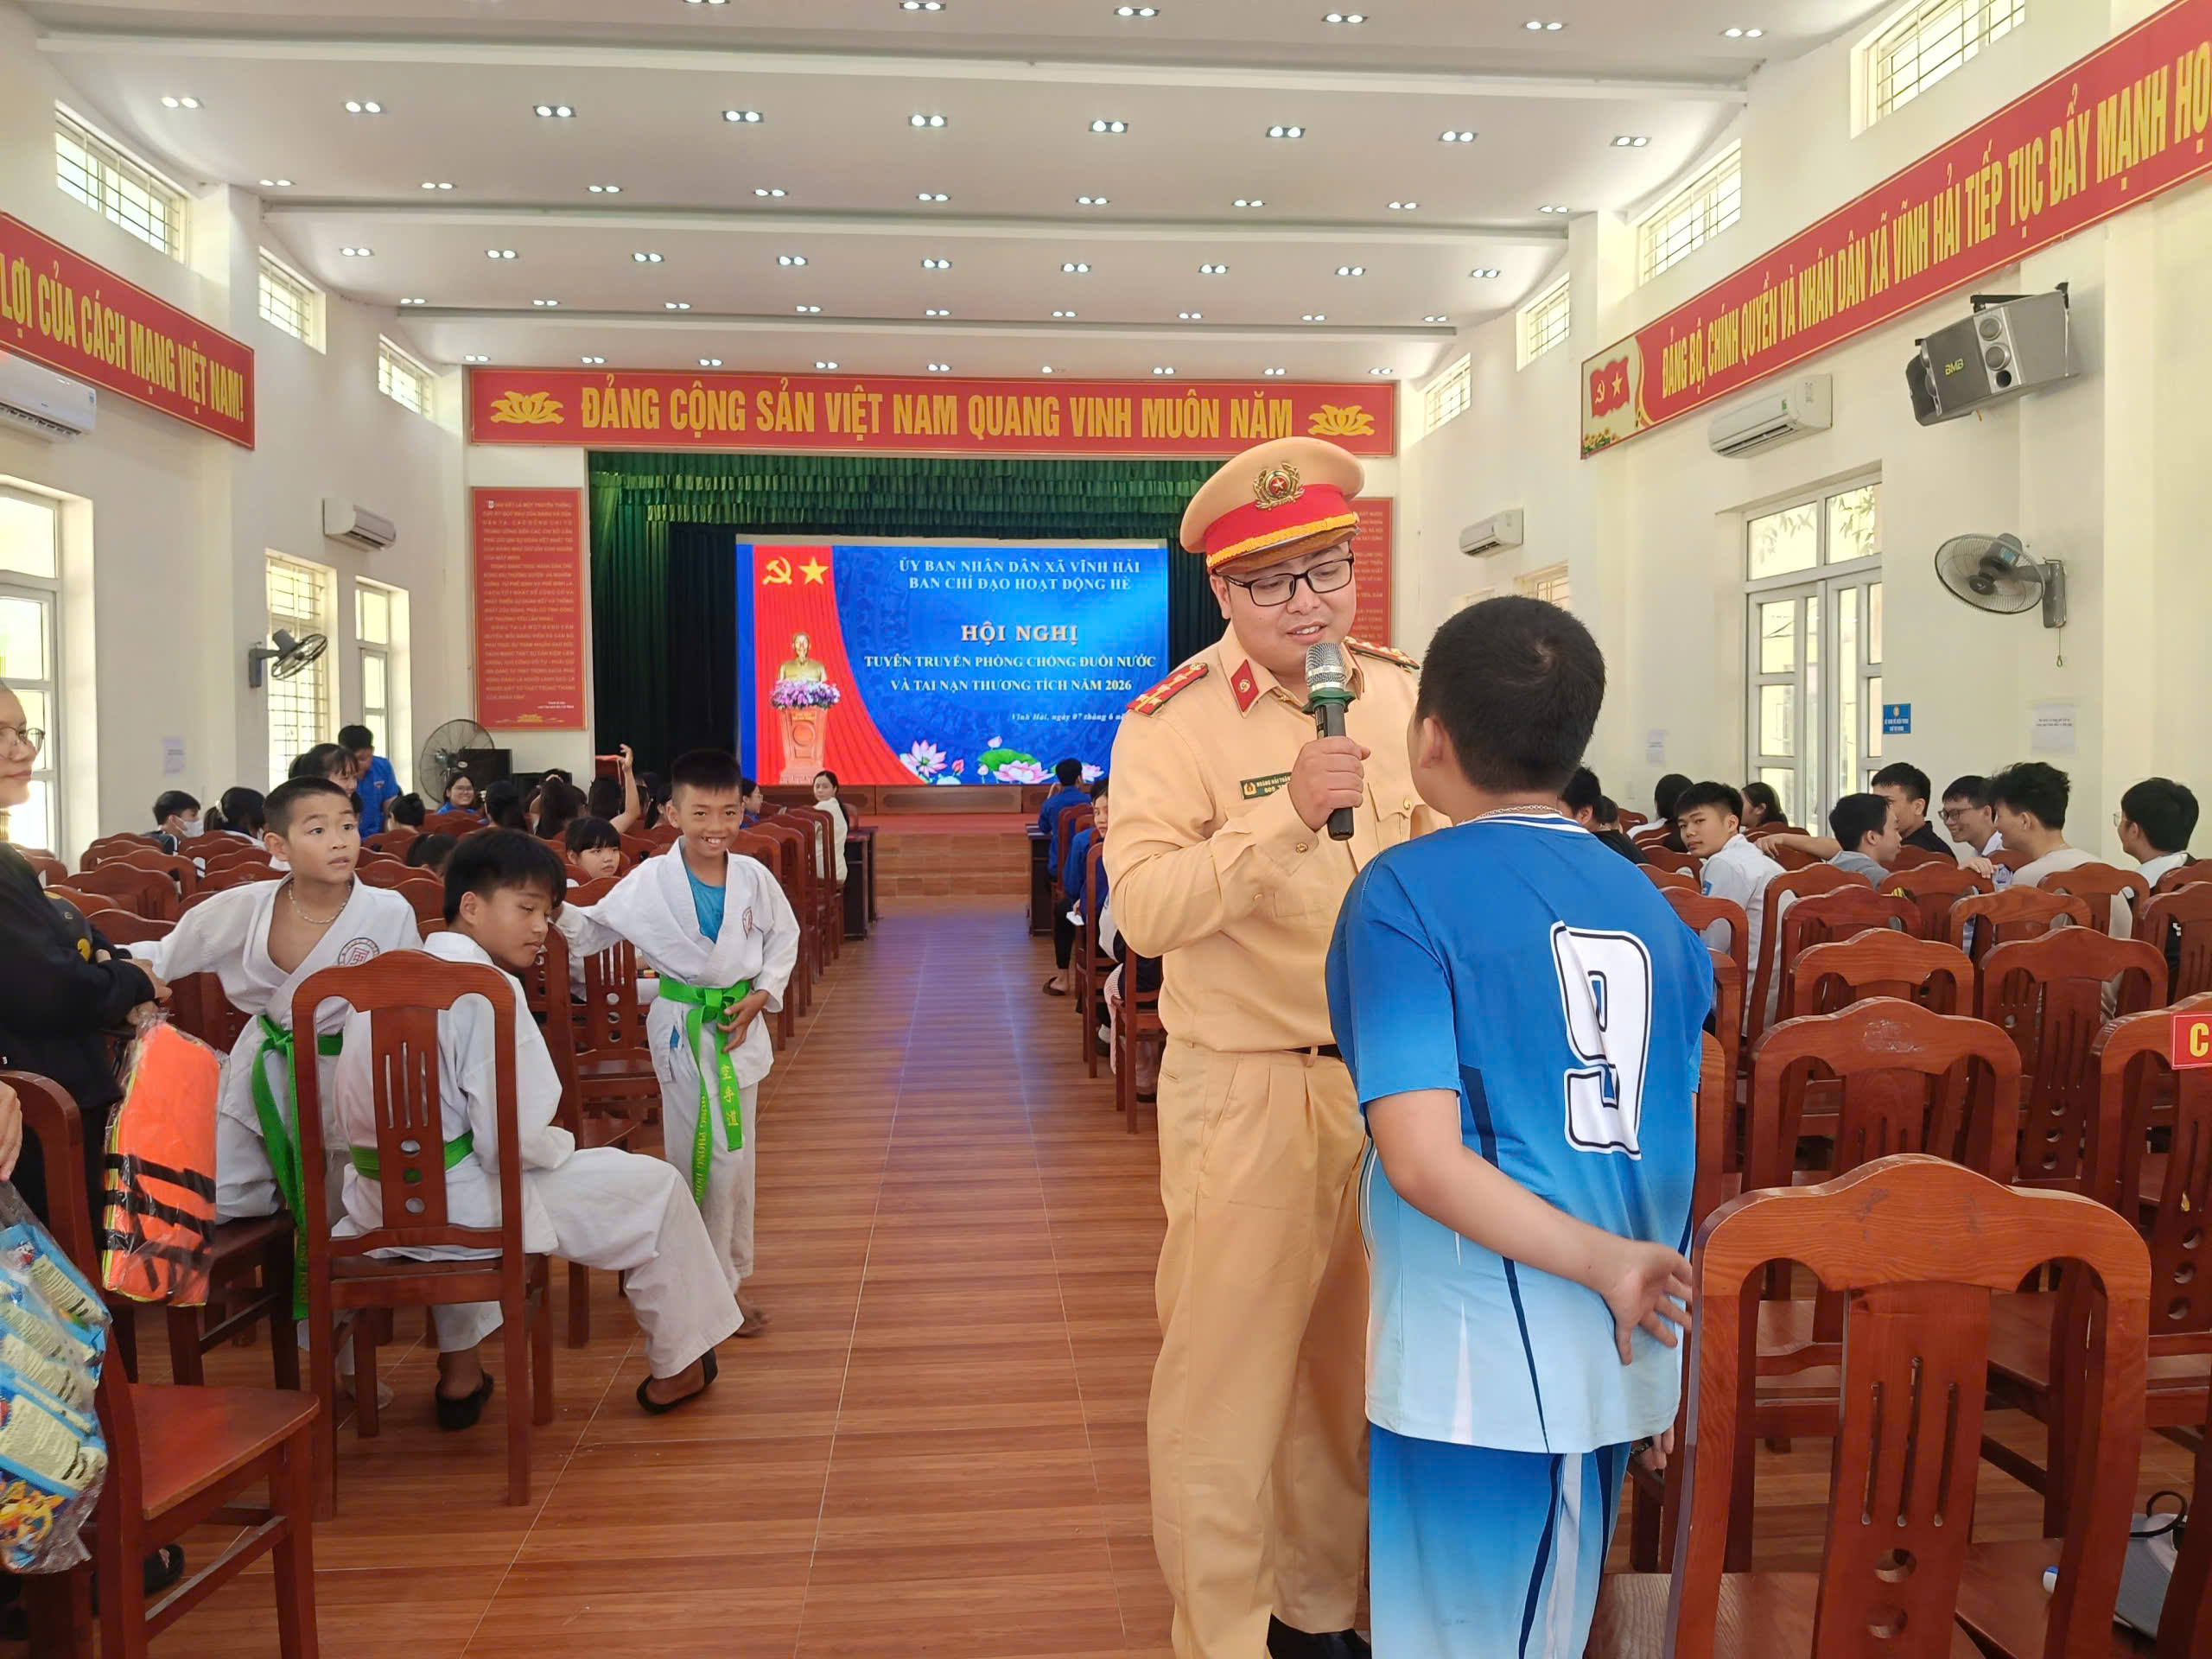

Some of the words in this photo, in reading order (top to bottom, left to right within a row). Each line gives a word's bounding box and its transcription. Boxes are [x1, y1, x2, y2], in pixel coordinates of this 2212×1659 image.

[1662, 327, 1687, 399] ĐẢNG
[1689, 318, 1705, 394] BỘ,
[1707, 304, 1738, 377] CHÍNH
[1741, 271, 1777, 365] QUYỀN
[1781, 264, 1796, 340] VÀ
[1799, 247, 1834, 332] NHÂN
[1838, 230, 1866, 313] DÂN
[1870, 211, 1889, 297] XÃ
[1892, 199, 1929, 283] VĨNH
[1933, 162, 1960, 264] HẢI
[1965, 139, 2002, 248] TIẾP
[2008, 137, 2044, 238] TỤC
[2049, 83, 2090, 207] ĐẨY
[2096, 65, 2168, 191] MẠNH
[2174, 41, 2212, 154] HỌ
[0, 252, 33, 339] LỢI
[38, 261, 76, 347] CỦA
[81, 290, 126, 370] CÁCH
[130, 320, 175, 394] MẠNG
[179, 340, 207, 415] VIỆT
[210, 359, 244, 422] NAM!
[1945, 359, 1964, 376] BMB
[582, 374, 660, 429] ĐẢNG
[671, 381, 746, 438] CỘNG
[757, 377, 815, 432] SẢN
[824, 385, 883, 442] VIỆT
[893, 393, 957, 435] NAM
[968, 395, 1060, 441] QUANG
[1070, 397, 1131, 438] VINH
[1141, 389, 1219, 439] MUÔN
[1230, 391, 1293, 438] NĂM
[925, 561, 956, 572] BAN
[961, 558, 1003, 572] NHÂN
[1008, 558, 1040, 572] DÂN
[1045, 559, 1065, 573] XÃ
[1071, 559, 1108, 573] VĨNH
[909, 577, 940, 589] BAN
[1015, 578, 1058, 592] HOẠT
[961, 620, 1007, 645] HỘI
[1016, 624, 1078, 646] NGHỊ
[864, 653, 912, 667] TUYÊN
[1116, 653, 1156, 667] NƯỚC
[891, 677, 910, 690] VÀ
[913, 680, 937, 690] TAI
[939, 680, 968, 694] NẠN
[972, 679, 1031, 690] THƯƠNG
[1035, 677, 1068, 690] TÍCH
[1071, 678, 1102, 690] NĂM
[1105, 679, 1132, 691] 2026
[1550, 920, 1653, 1160] 9
